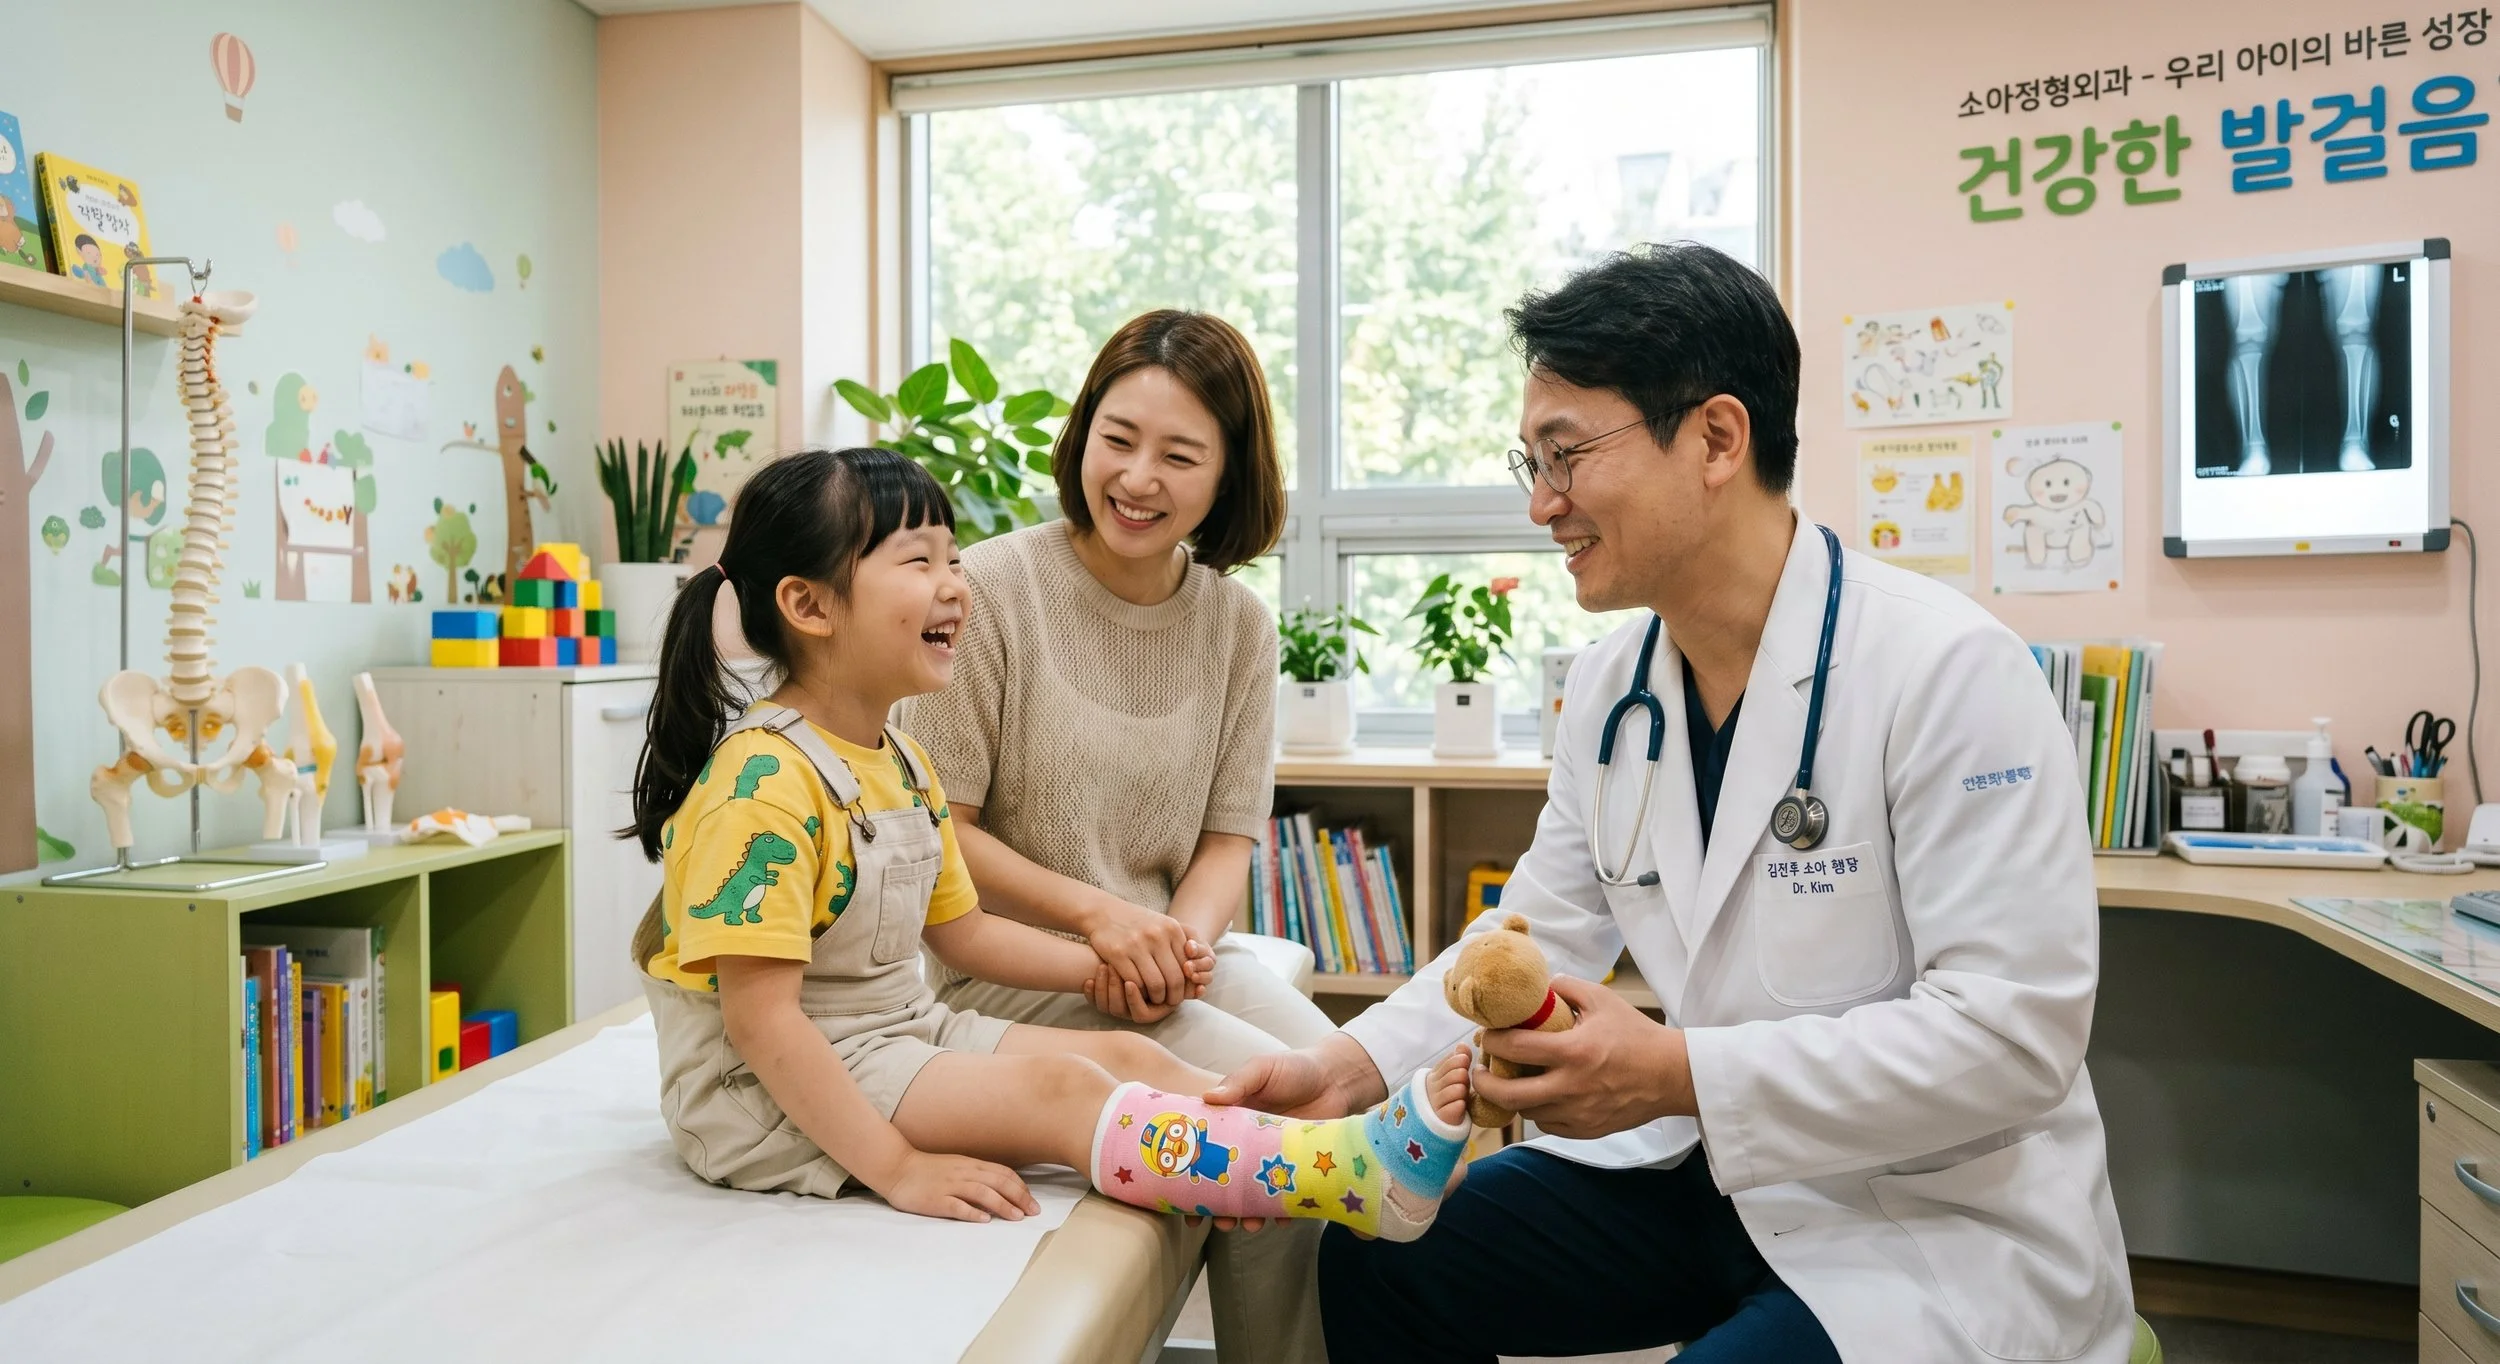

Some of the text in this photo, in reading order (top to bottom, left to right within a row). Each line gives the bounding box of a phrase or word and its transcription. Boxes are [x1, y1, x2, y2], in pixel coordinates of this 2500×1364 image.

[1957, 65, 2133, 118] 소아정형외과
[2164, 50, 2224, 89] 우리
[2237, 33, 2332, 77] 아이의
[2345, 21, 2411, 60] 바른
[2422, 7, 2493, 51] 성장
[1958, 74, 2490, 223] 건강한 발걸음
[2393, 267, 2405, 282] L
[1803, 860, 1827, 876] 소아
[1792, 881, 1835, 894] Dr. Kim
